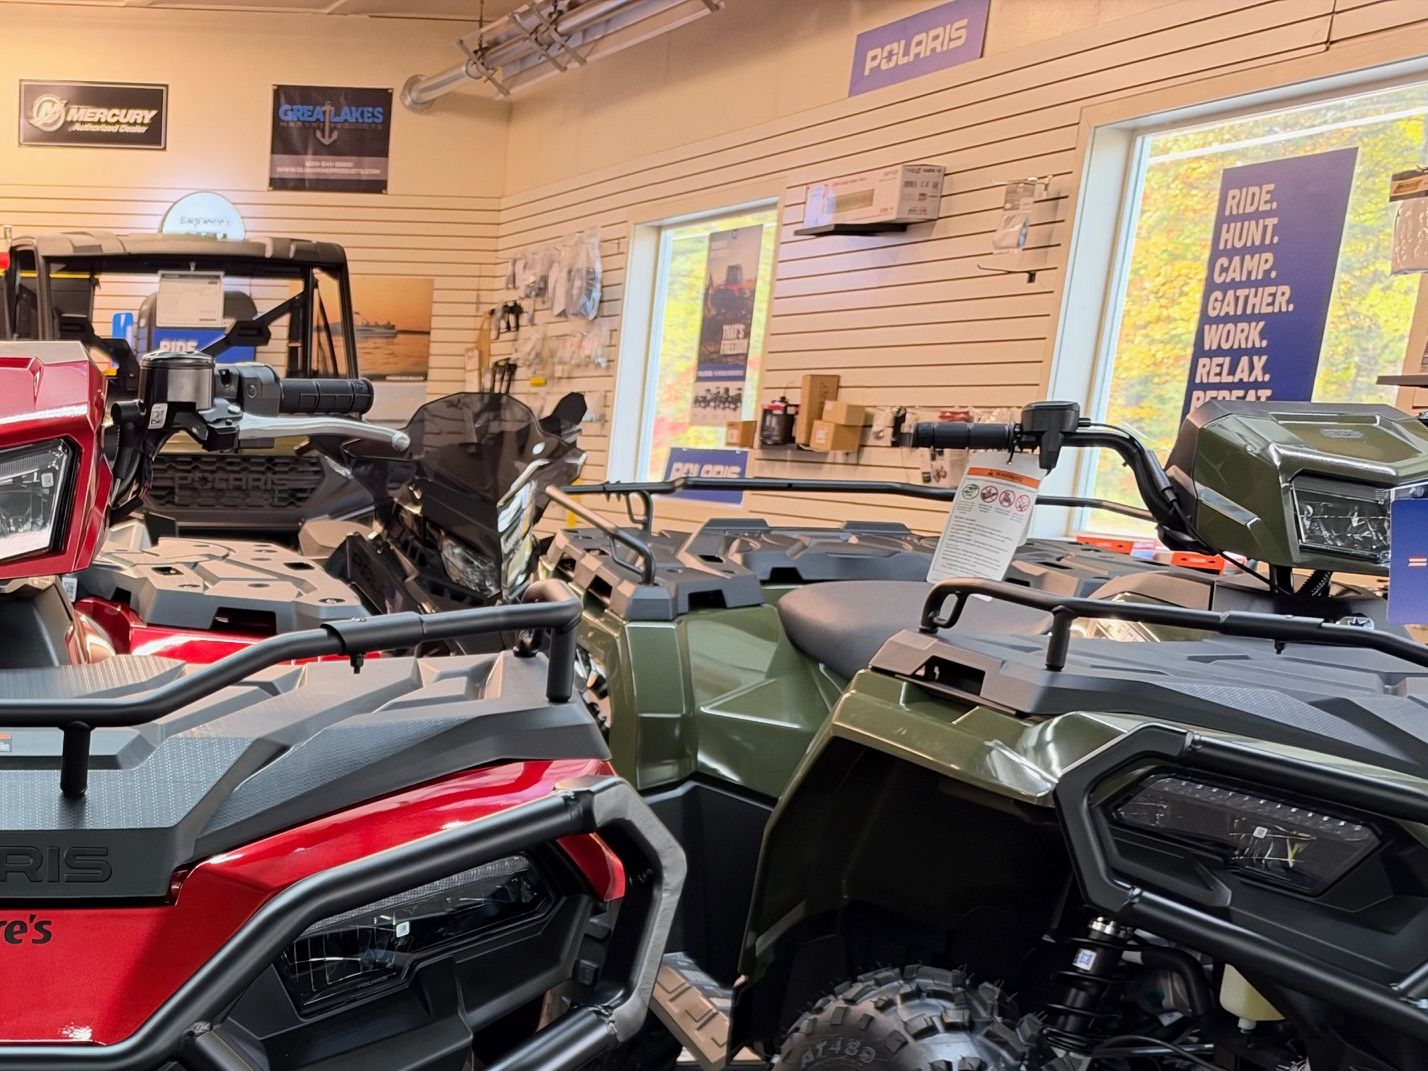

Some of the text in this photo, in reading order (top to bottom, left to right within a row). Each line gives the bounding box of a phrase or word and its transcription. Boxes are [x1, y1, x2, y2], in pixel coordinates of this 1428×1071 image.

[864, 18, 968, 76] POLARIS
[66, 108, 158, 123] MERCURY
[70, 123, 149, 133] Authorized Dealer
[330, 106, 383, 123] LAKES
[1225, 183, 1278, 216] RIDE.
[1218, 217, 1279, 250] HUNT.
[1213, 252, 1277, 284] CAMP.
[1207, 285, 1294, 317] GATHER.
[1203, 320, 1268, 350] WORK.
[1195, 354, 1271, 383] RELAX.
